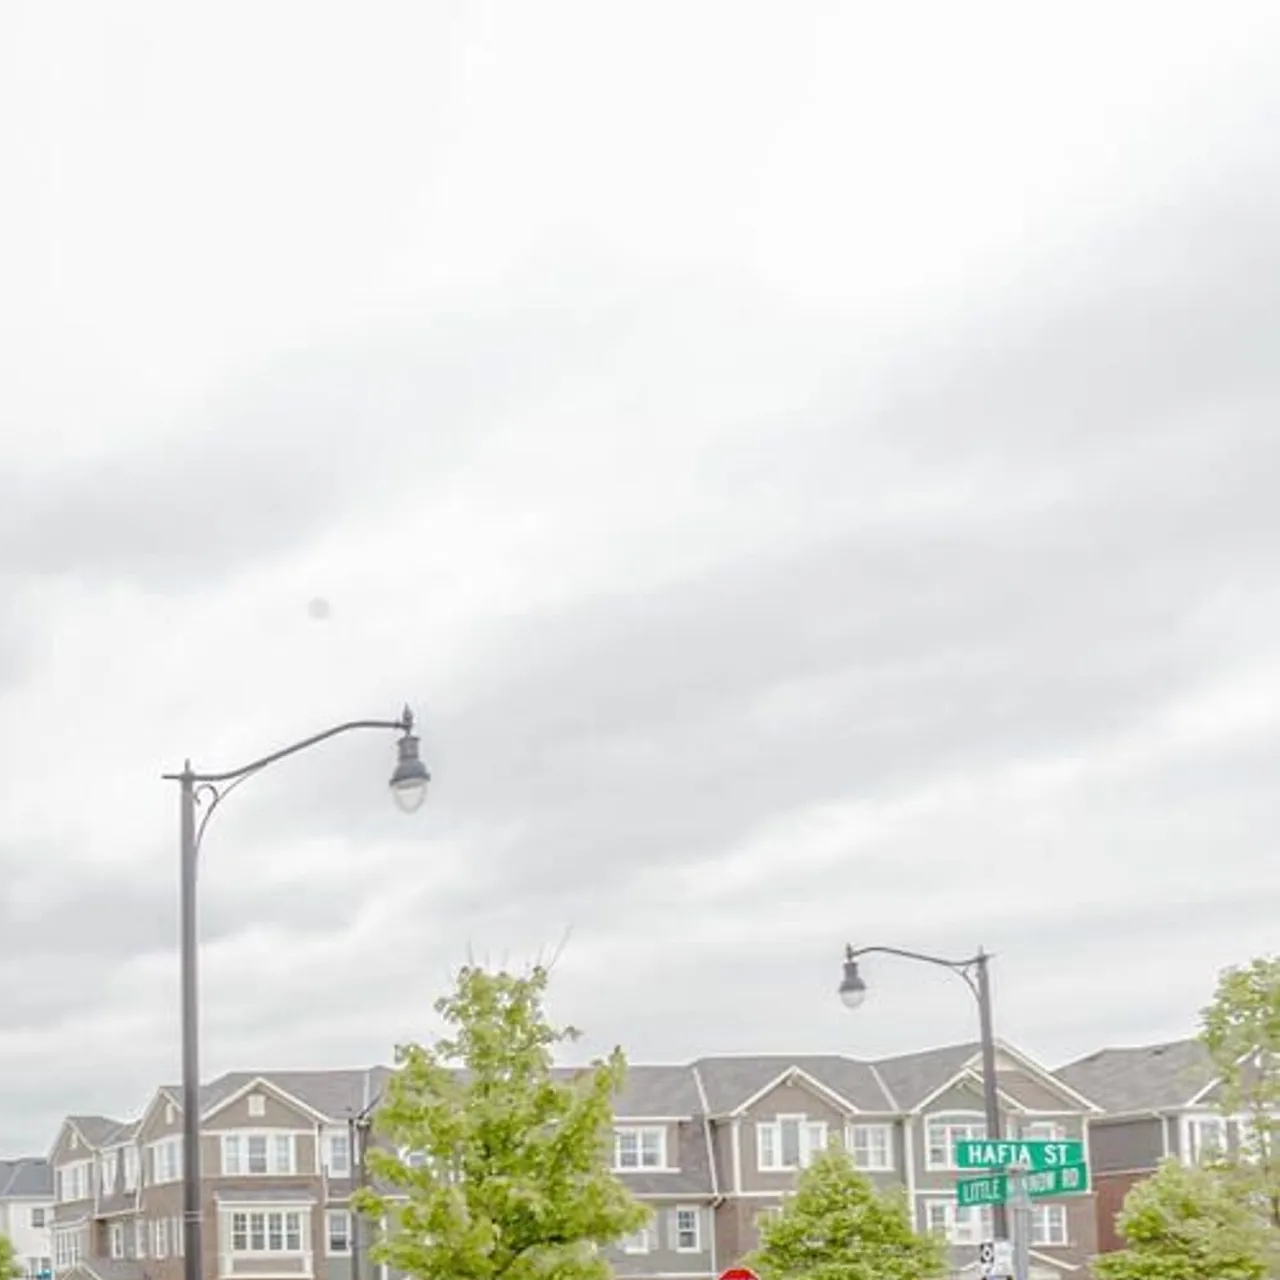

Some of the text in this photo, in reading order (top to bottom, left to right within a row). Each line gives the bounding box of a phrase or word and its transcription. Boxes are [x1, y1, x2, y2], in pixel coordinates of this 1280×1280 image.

[967, 1143, 1069, 1167] HAFIA ST
[963, 1178, 1001, 1203] LITTLE
